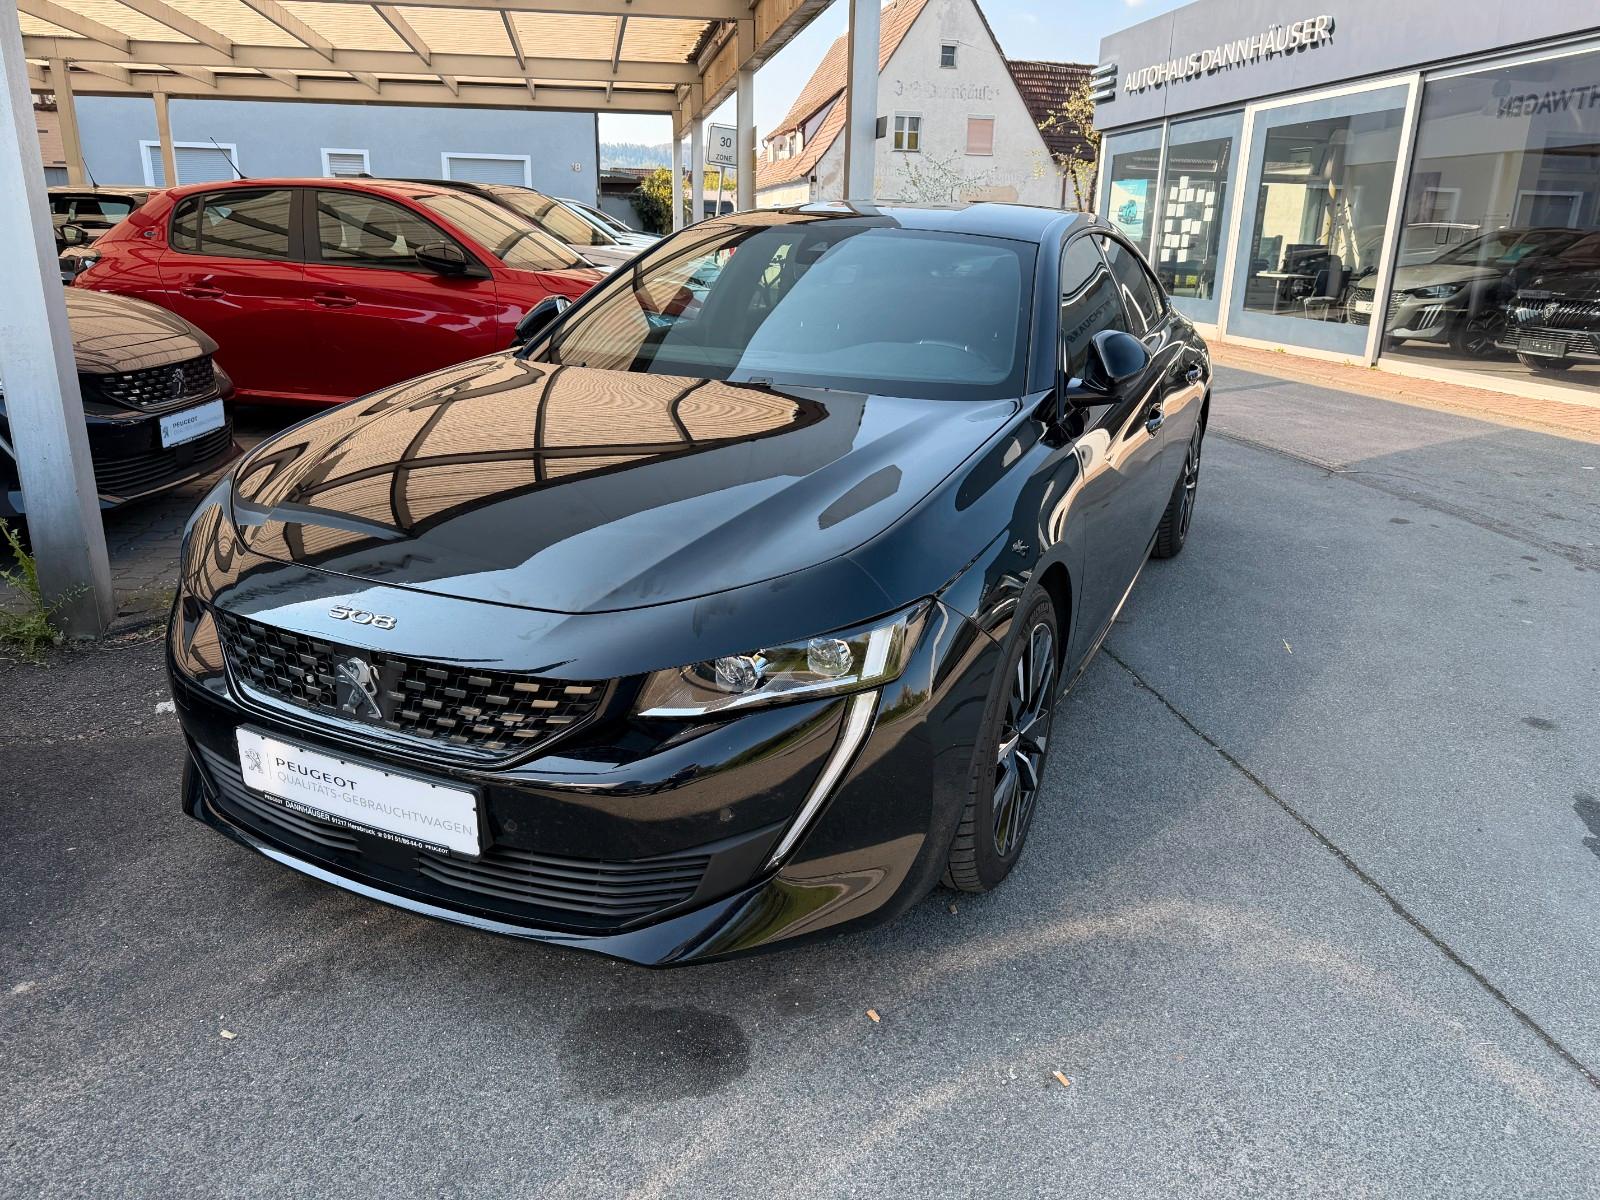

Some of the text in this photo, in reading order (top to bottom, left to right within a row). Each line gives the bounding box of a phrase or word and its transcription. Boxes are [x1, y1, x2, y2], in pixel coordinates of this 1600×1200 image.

[1124, 15, 1332, 93] AUTOHAUS DANNHÄUSER
[720, 136, 732, 148] 30
[571, 161, 581, 171] 18
[715, 153, 733, 162] ZONE
[172, 415, 198, 429] PEUGEOT
[328, 605, 397, 630] 508
[275, 756, 357, 791] PEUGEOT
[277, 770, 473, 836] QUALITÄTS-GEBRAUCHTWAGEN
